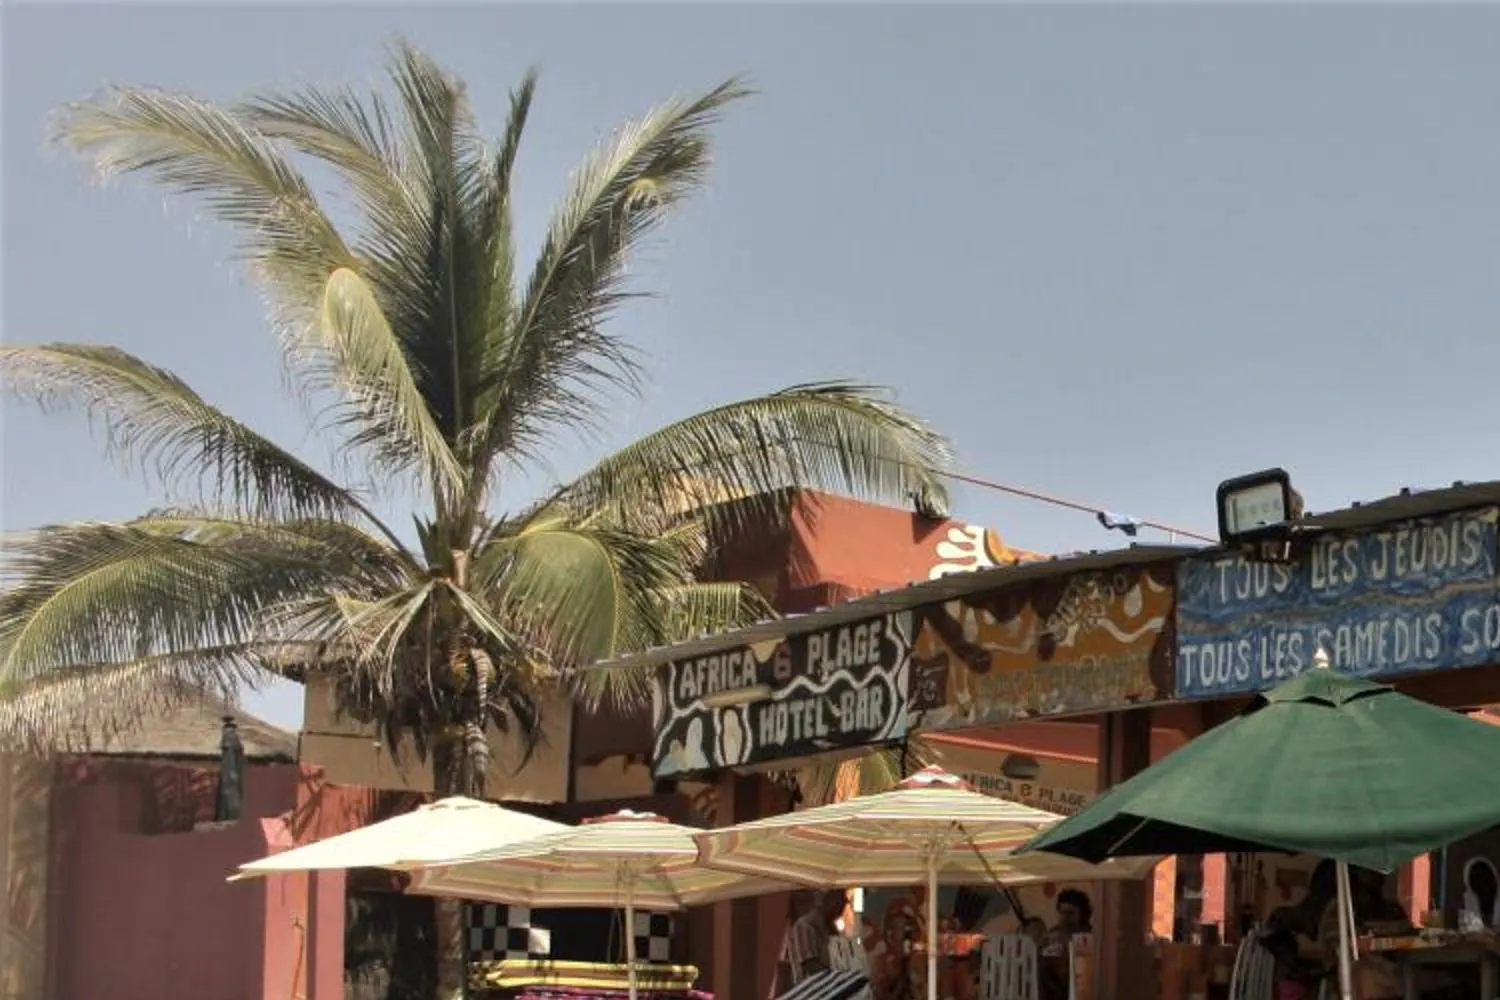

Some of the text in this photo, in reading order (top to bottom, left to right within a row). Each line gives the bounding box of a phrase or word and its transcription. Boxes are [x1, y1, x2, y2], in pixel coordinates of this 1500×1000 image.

[1215, 558, 1290, 603] TOUS
[1311, 540, 1359, 589] LES
[1371, 520, 1480, 579] JEUDIS
[679, 648, 757, 698] AFRICA
[807, 621, 882, 676] PLAGE
[1180, 643, 1250, 688] TOUS
[1261, 632, 1303, 680] LES
[1317, 613, 1442, 669] SAMEDIS
[759, 685, 884, 747] HOTEL BAR
